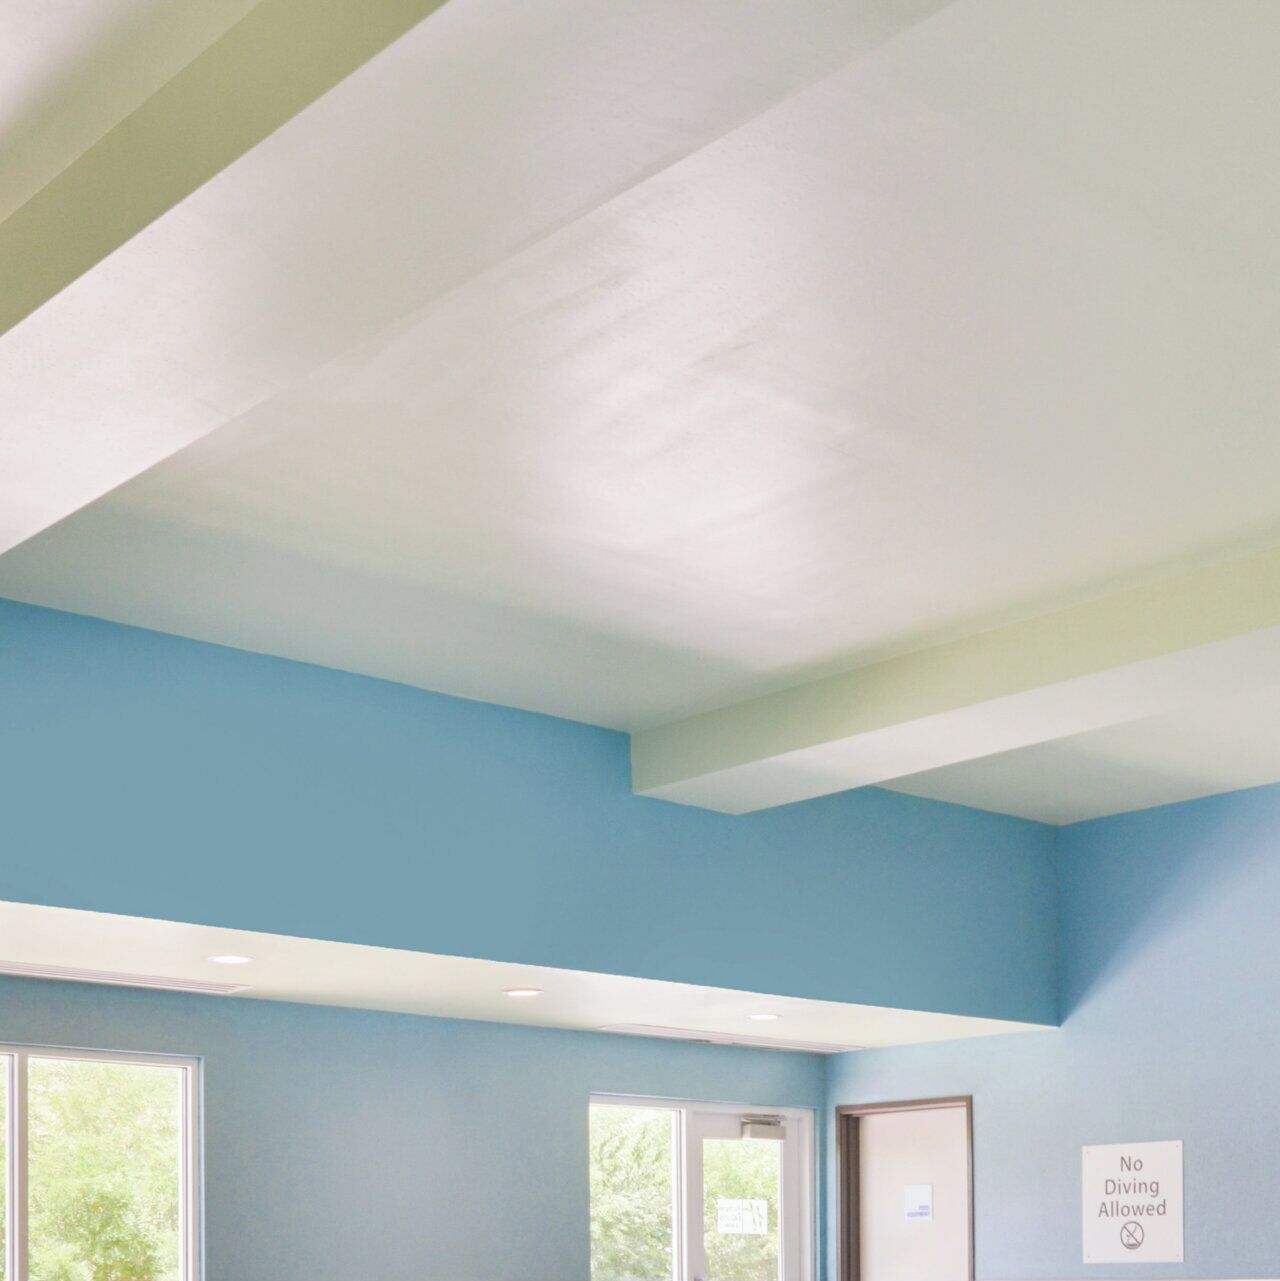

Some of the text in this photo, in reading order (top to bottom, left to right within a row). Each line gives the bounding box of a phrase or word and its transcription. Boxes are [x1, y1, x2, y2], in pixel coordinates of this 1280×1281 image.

[1120, 1155, 1144, 1172] No
[1104, 1178, 1160, 1198] Diving
[1098, 1199, 1167, 1217] Allowed
